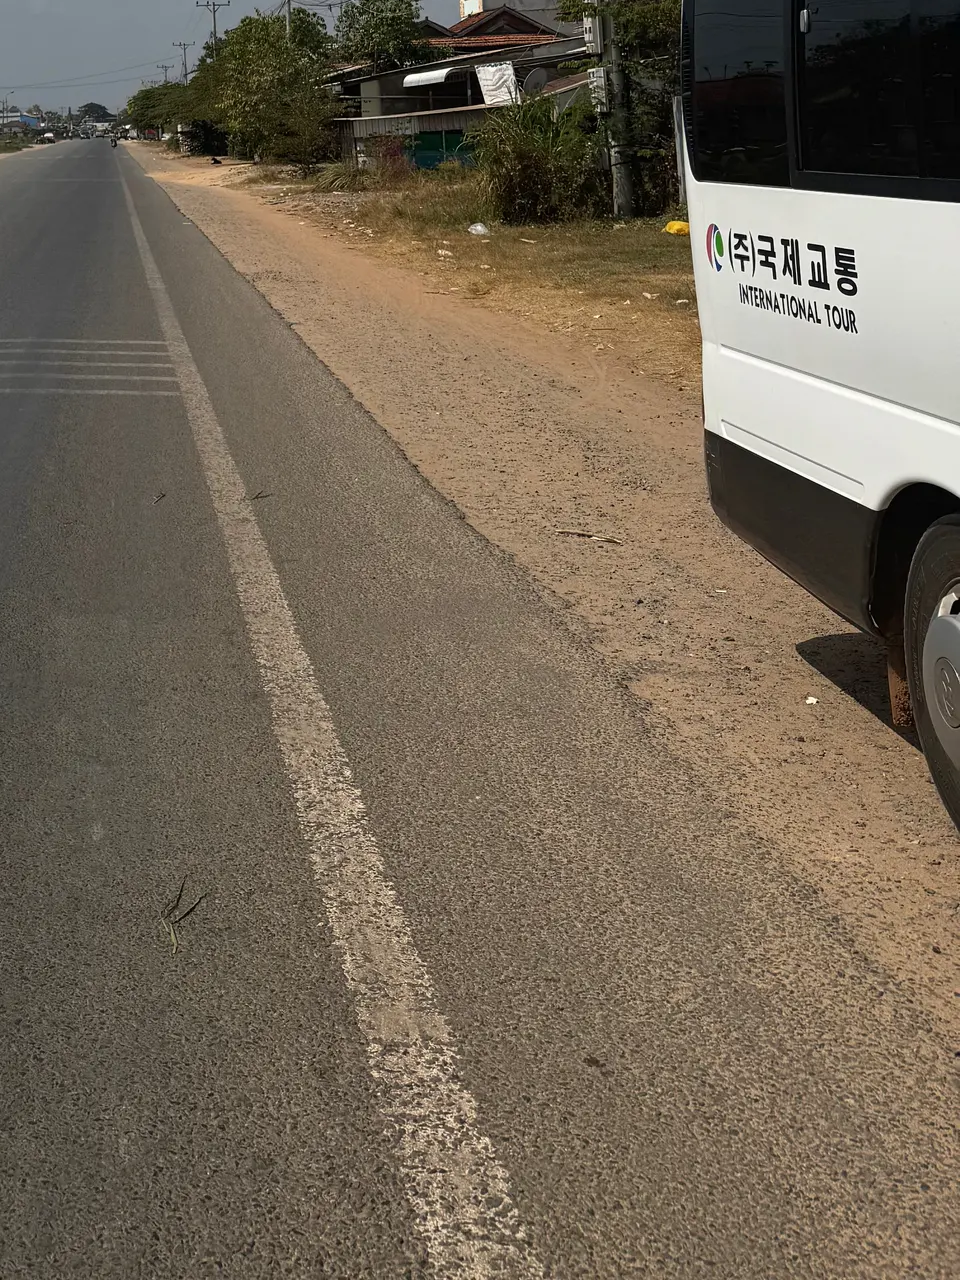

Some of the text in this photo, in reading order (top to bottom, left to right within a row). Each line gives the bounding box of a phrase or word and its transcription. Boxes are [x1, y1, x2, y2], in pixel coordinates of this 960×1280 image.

[728, 228, 858, 296] (주)국제교통
[739, 283, 858, 334] INTERNATIONAL TOUR
